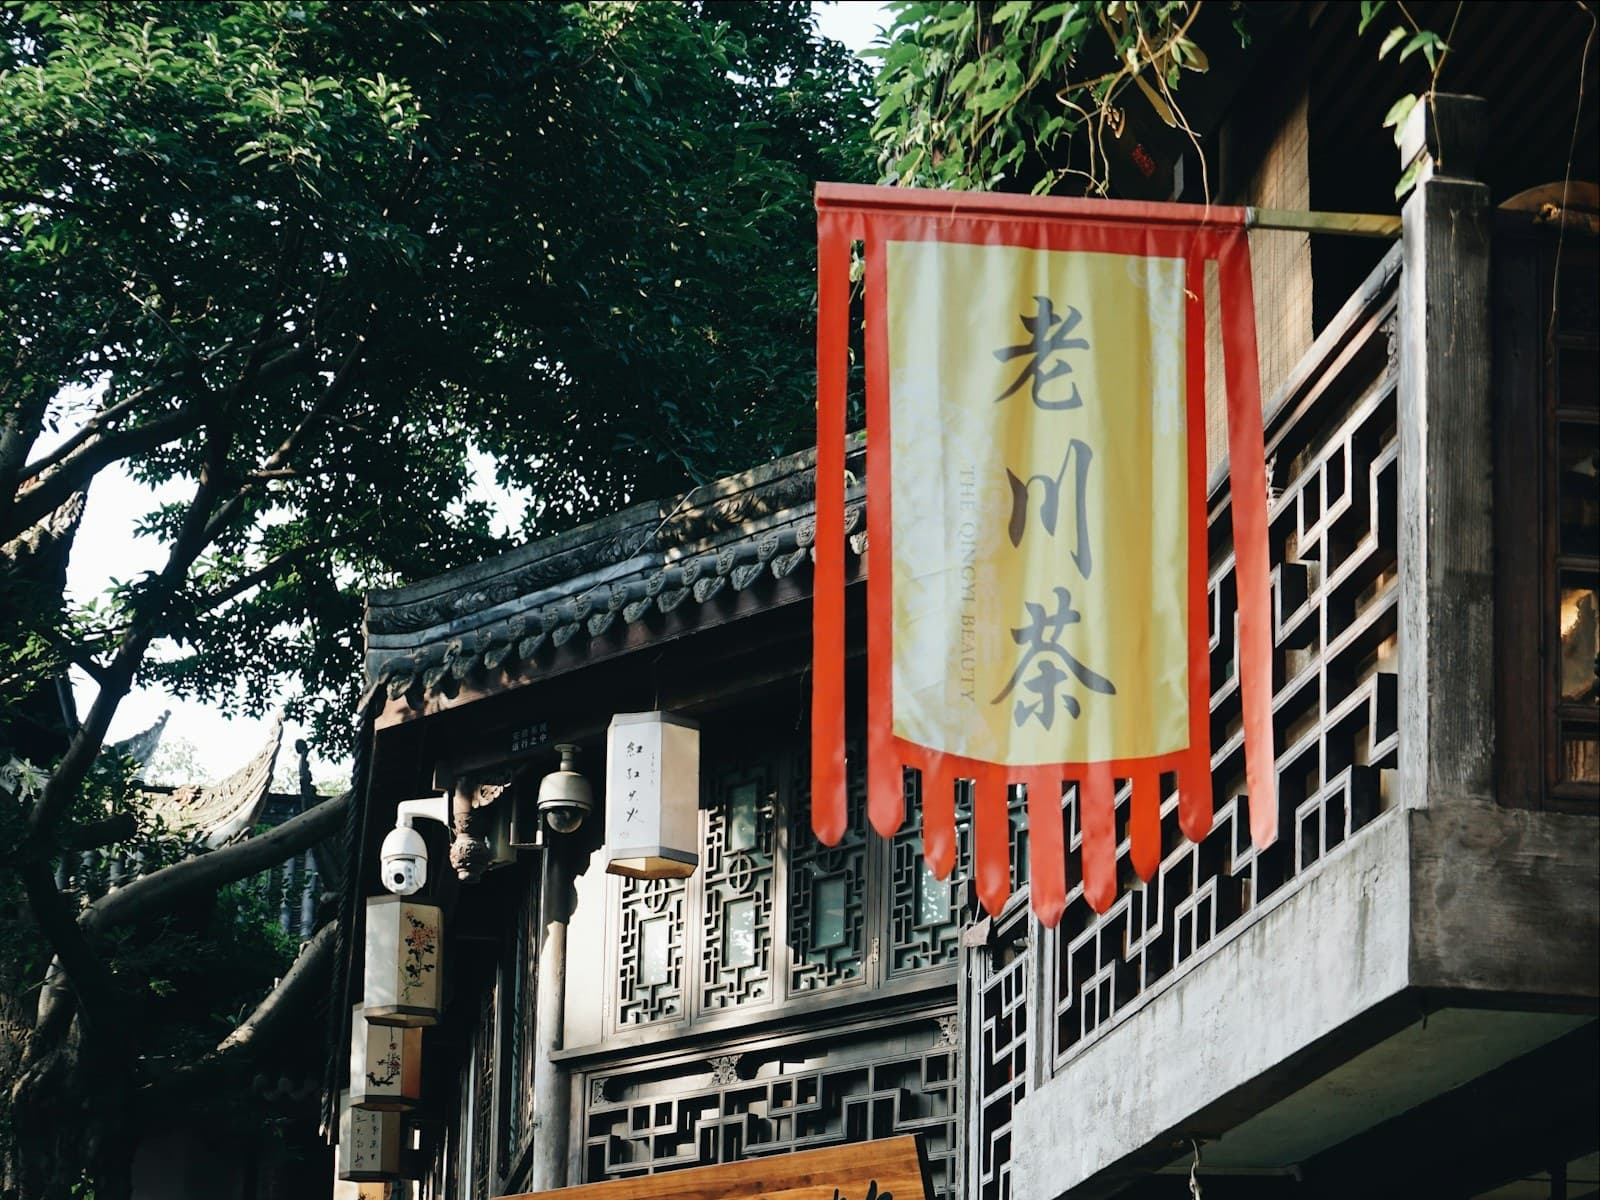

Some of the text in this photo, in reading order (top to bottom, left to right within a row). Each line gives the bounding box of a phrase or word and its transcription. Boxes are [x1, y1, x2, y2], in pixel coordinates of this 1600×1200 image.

[959, 465, 975, 512] THE
[992, 296, 1116, 731] 老川茶
[960, 614, 976, 703] BEAUTY
